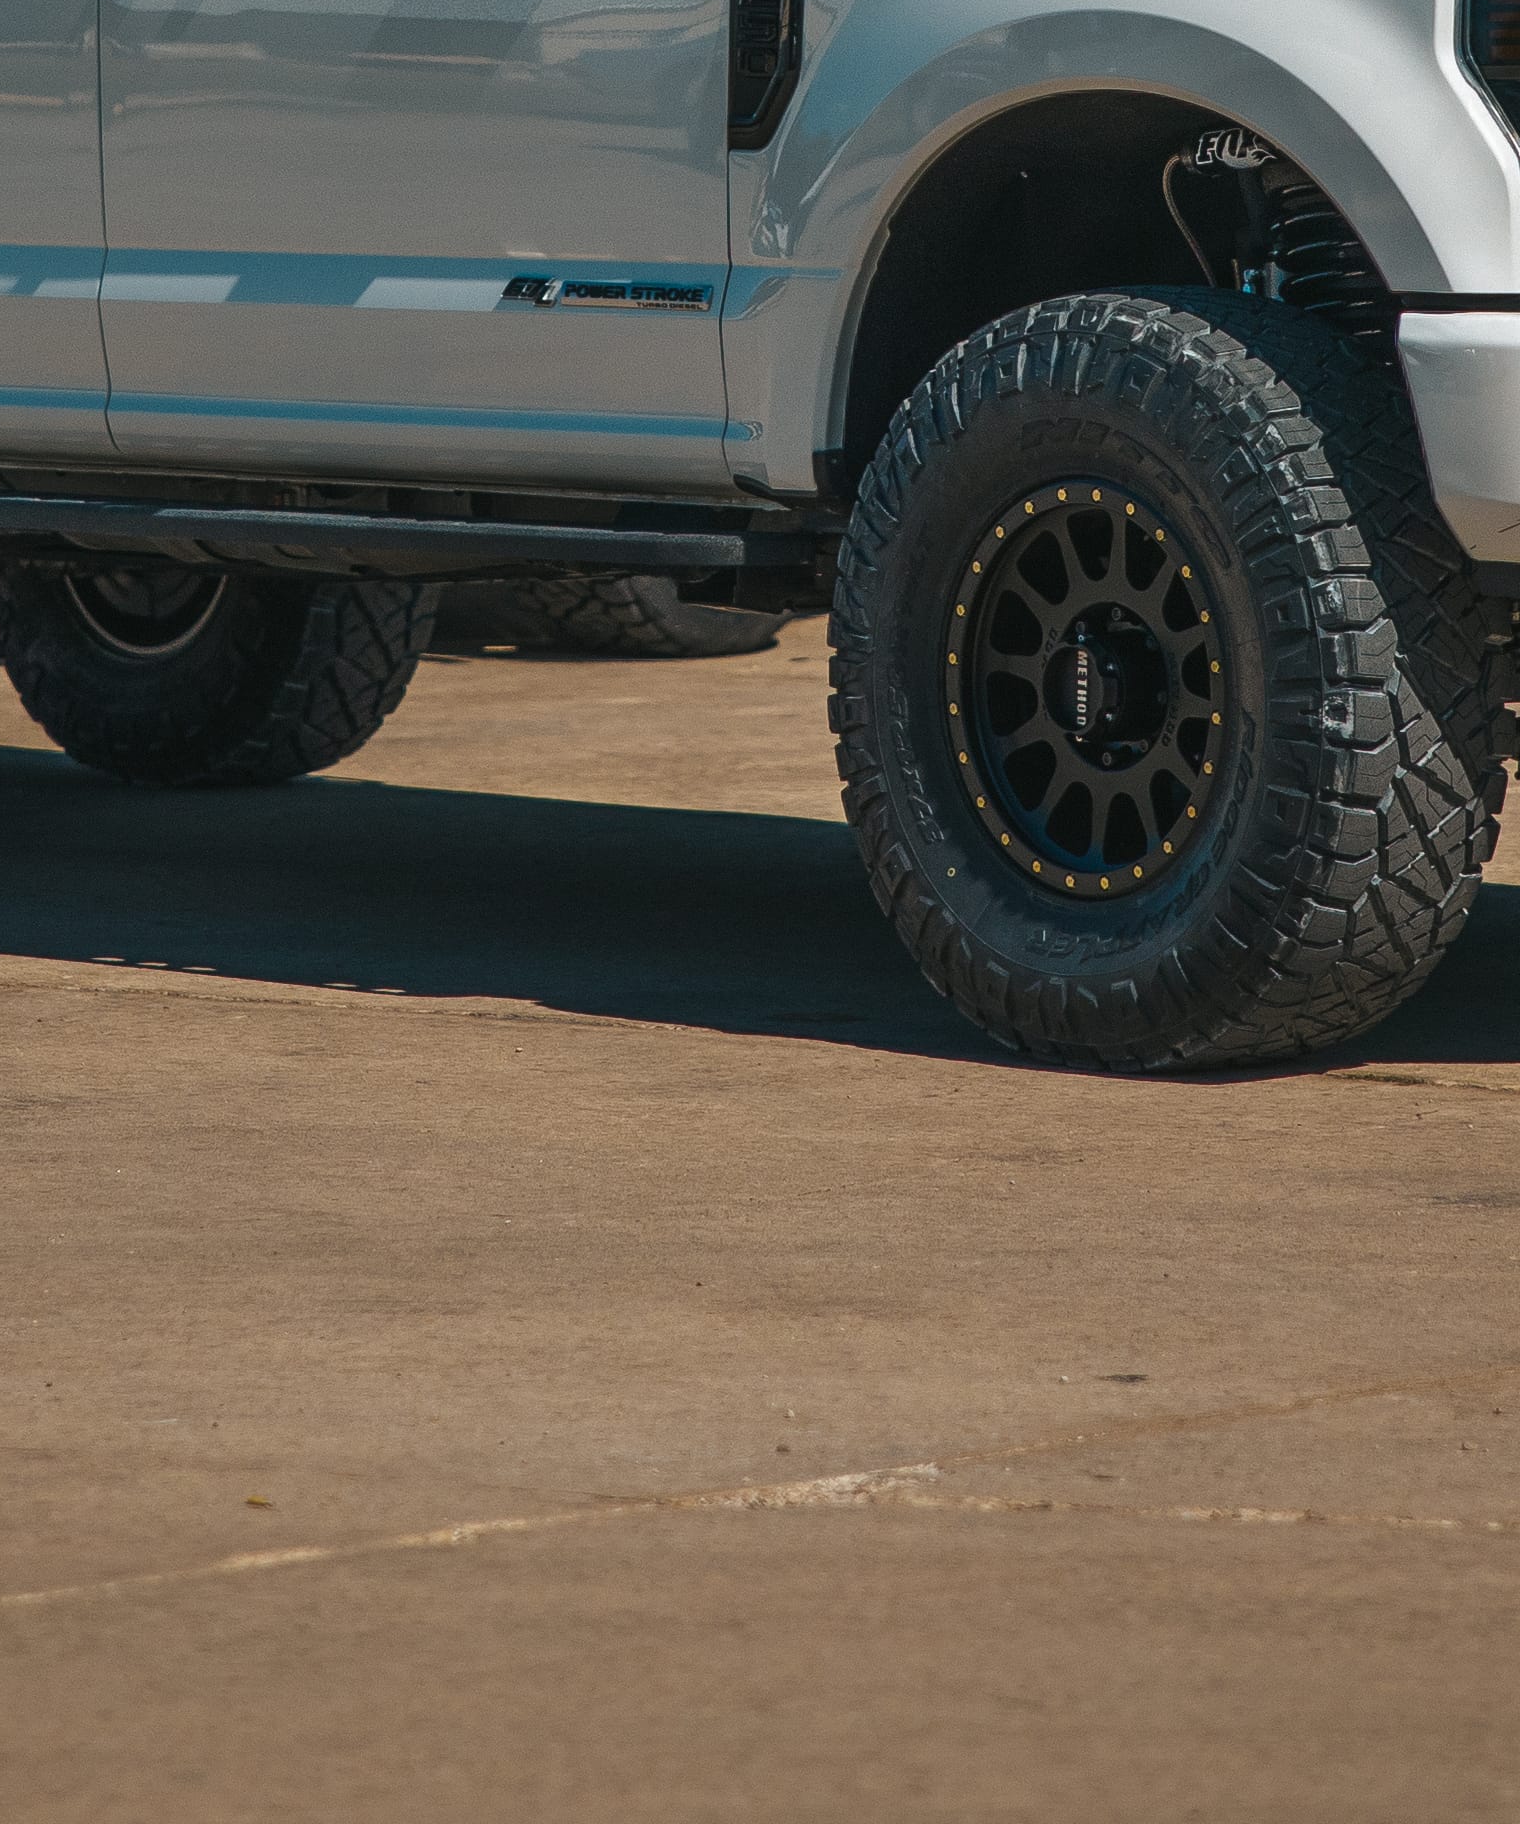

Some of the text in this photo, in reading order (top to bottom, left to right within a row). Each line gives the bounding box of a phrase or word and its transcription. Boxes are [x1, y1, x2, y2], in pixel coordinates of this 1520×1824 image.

[564, 283, 626, 299] POWER
[630, 286, 705, 303] STROKE
[1076, 648, 1089, 726] METHOD
